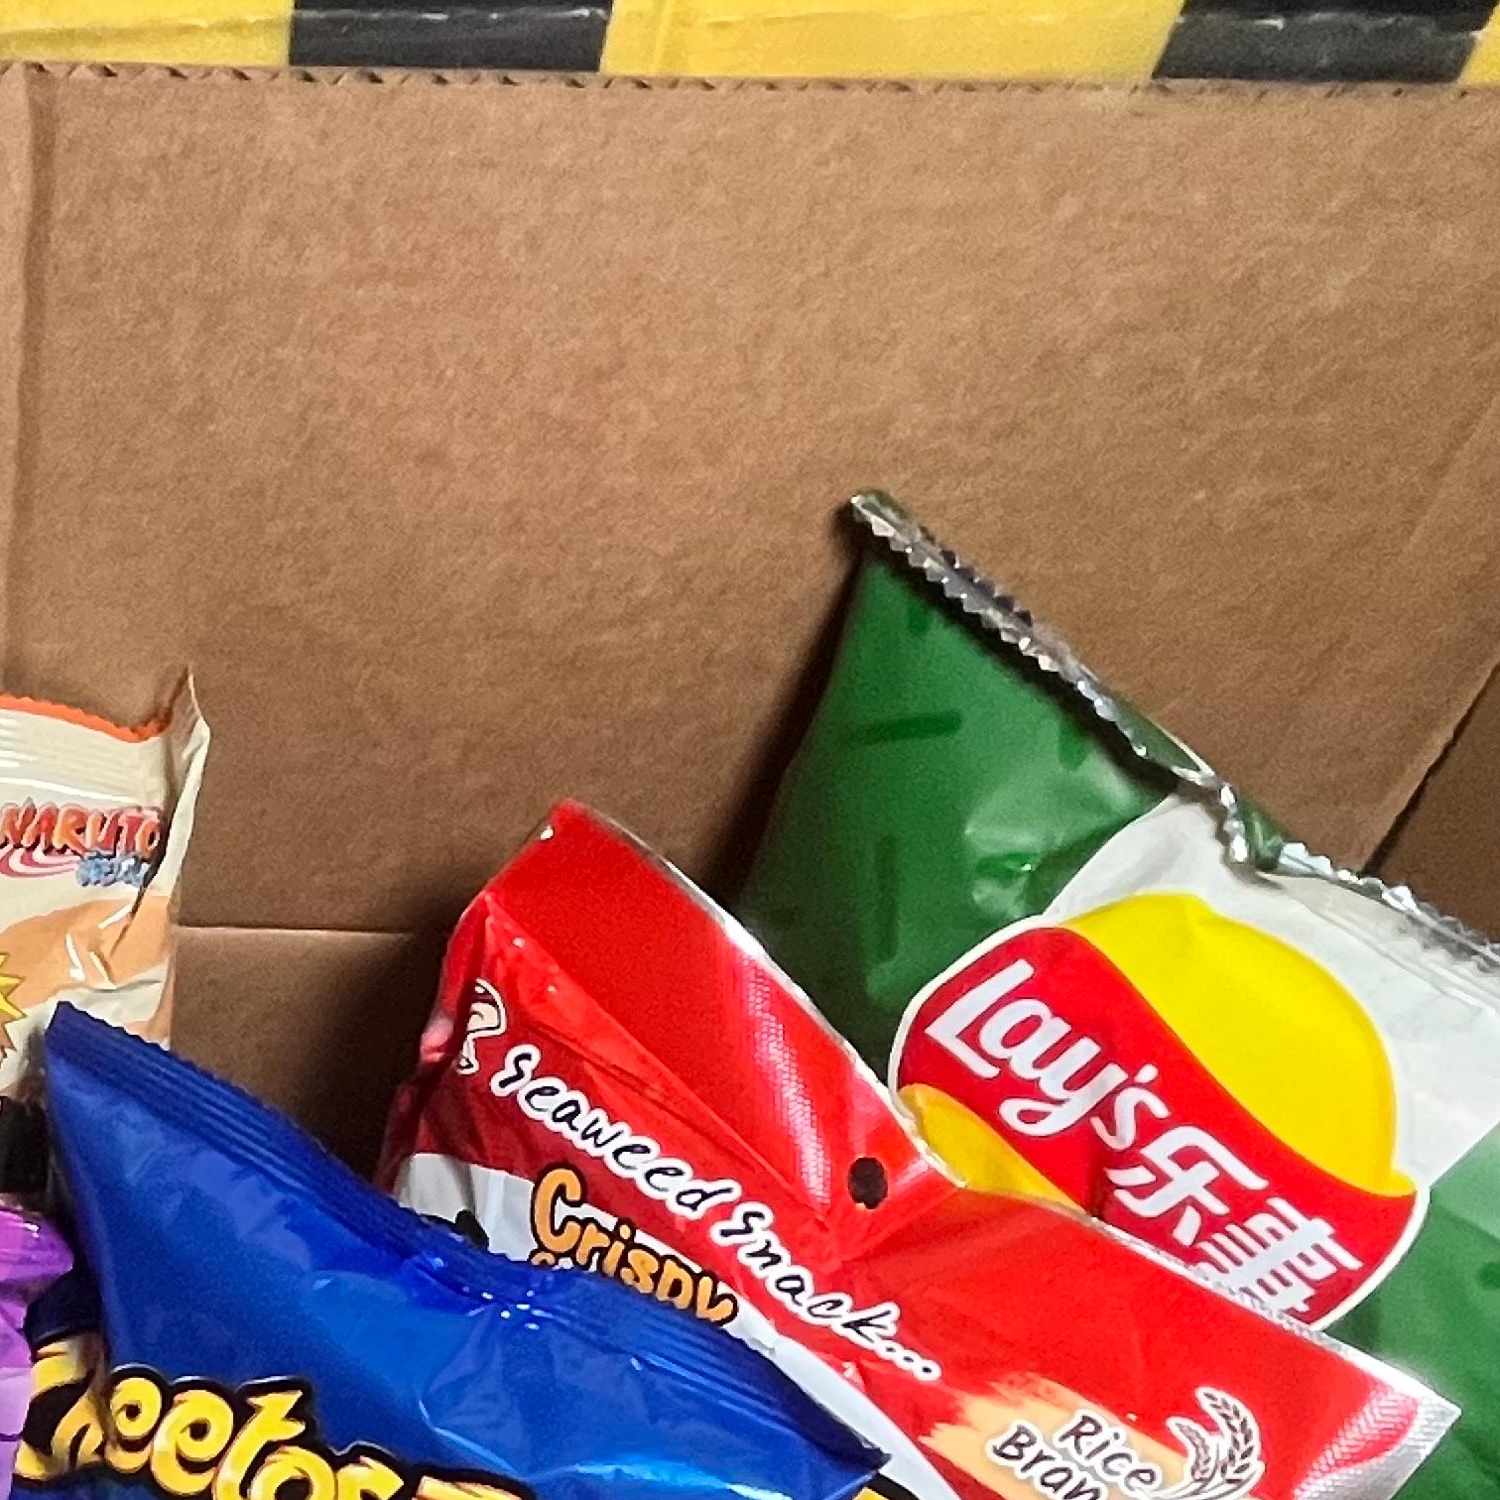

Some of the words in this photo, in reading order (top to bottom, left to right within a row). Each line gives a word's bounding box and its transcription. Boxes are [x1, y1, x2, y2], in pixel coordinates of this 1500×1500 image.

[490, 1044, 741, 1222] Seaweed
[925, 959, 1174, 1150] Lay's
[1055, 1408, 1166, 1496] Rice
